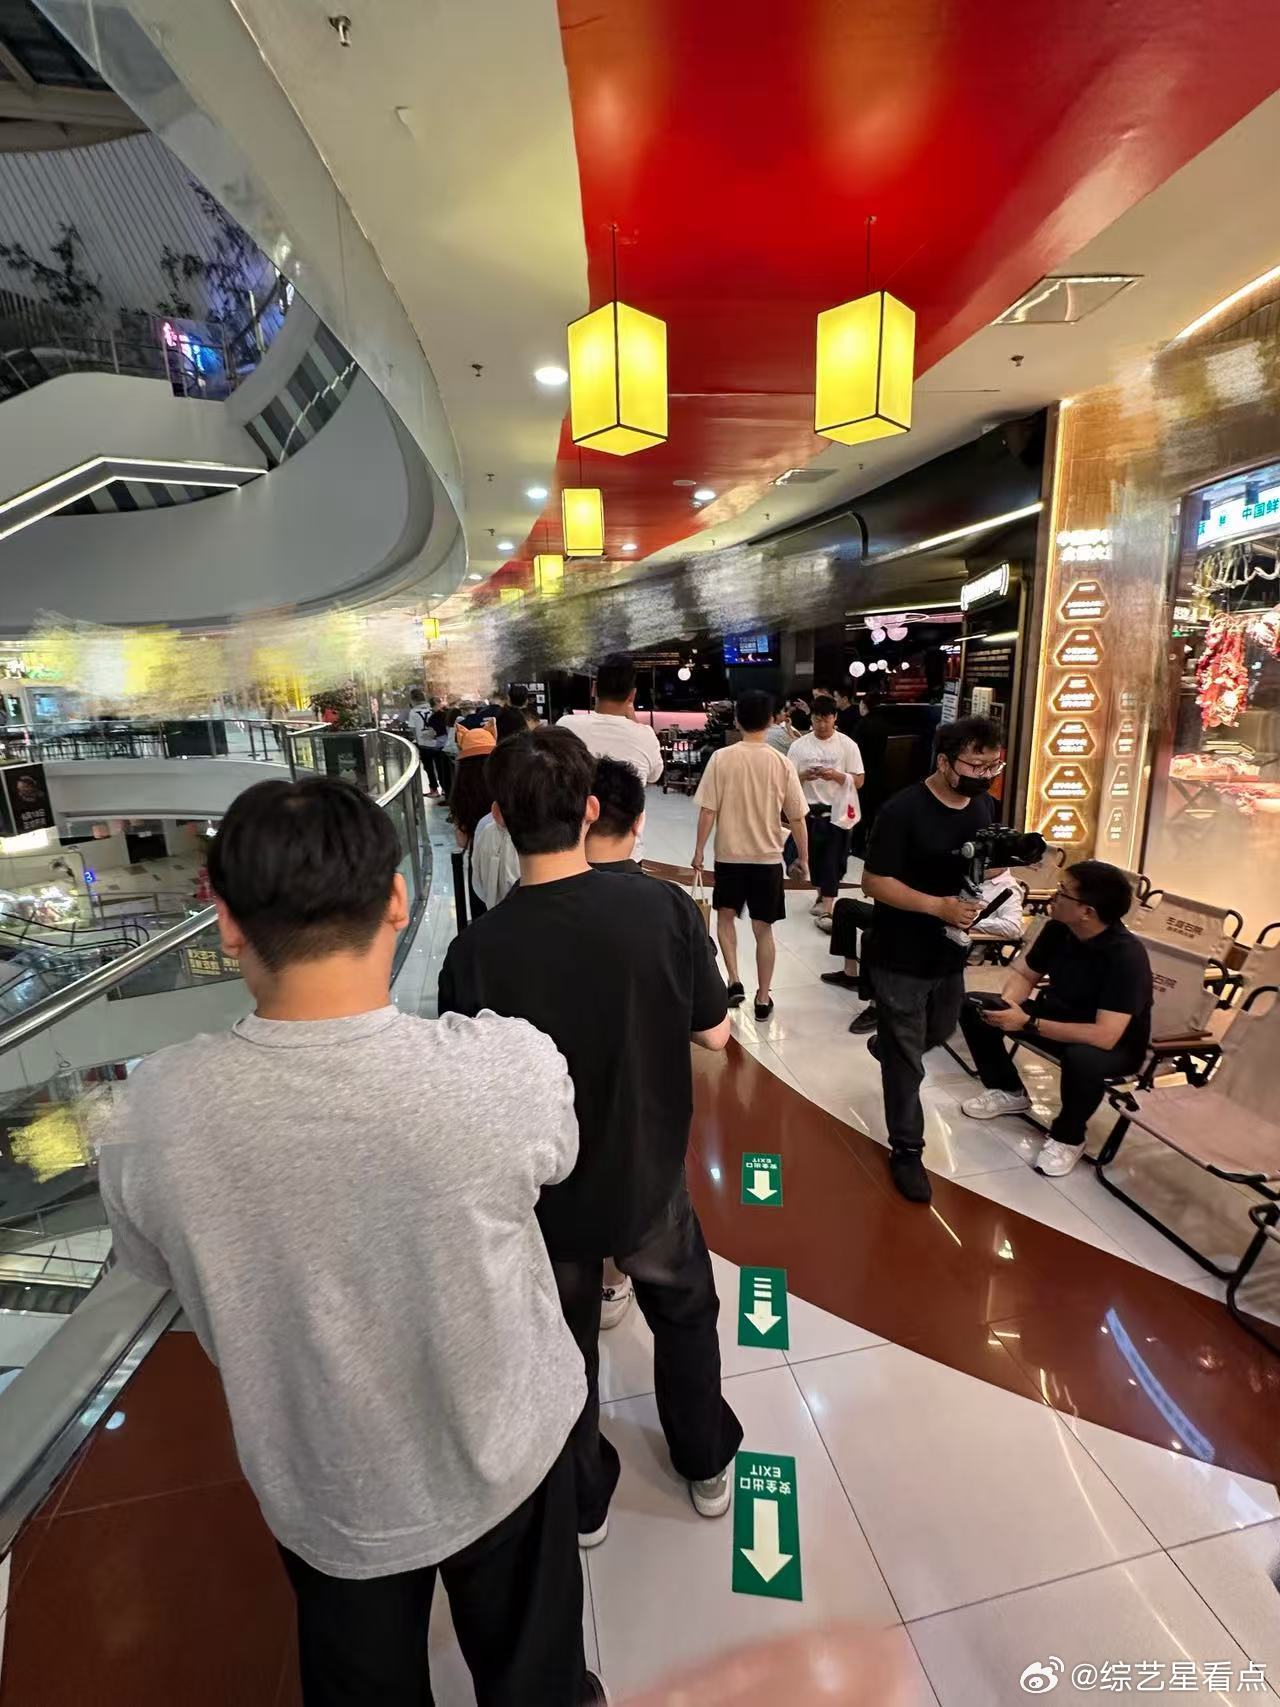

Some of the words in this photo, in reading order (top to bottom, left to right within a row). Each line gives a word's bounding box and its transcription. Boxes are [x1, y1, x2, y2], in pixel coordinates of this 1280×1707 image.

[750, 1464, 781, 1478] EXIT
[740, 1477, 791, 1495] 安全出口
